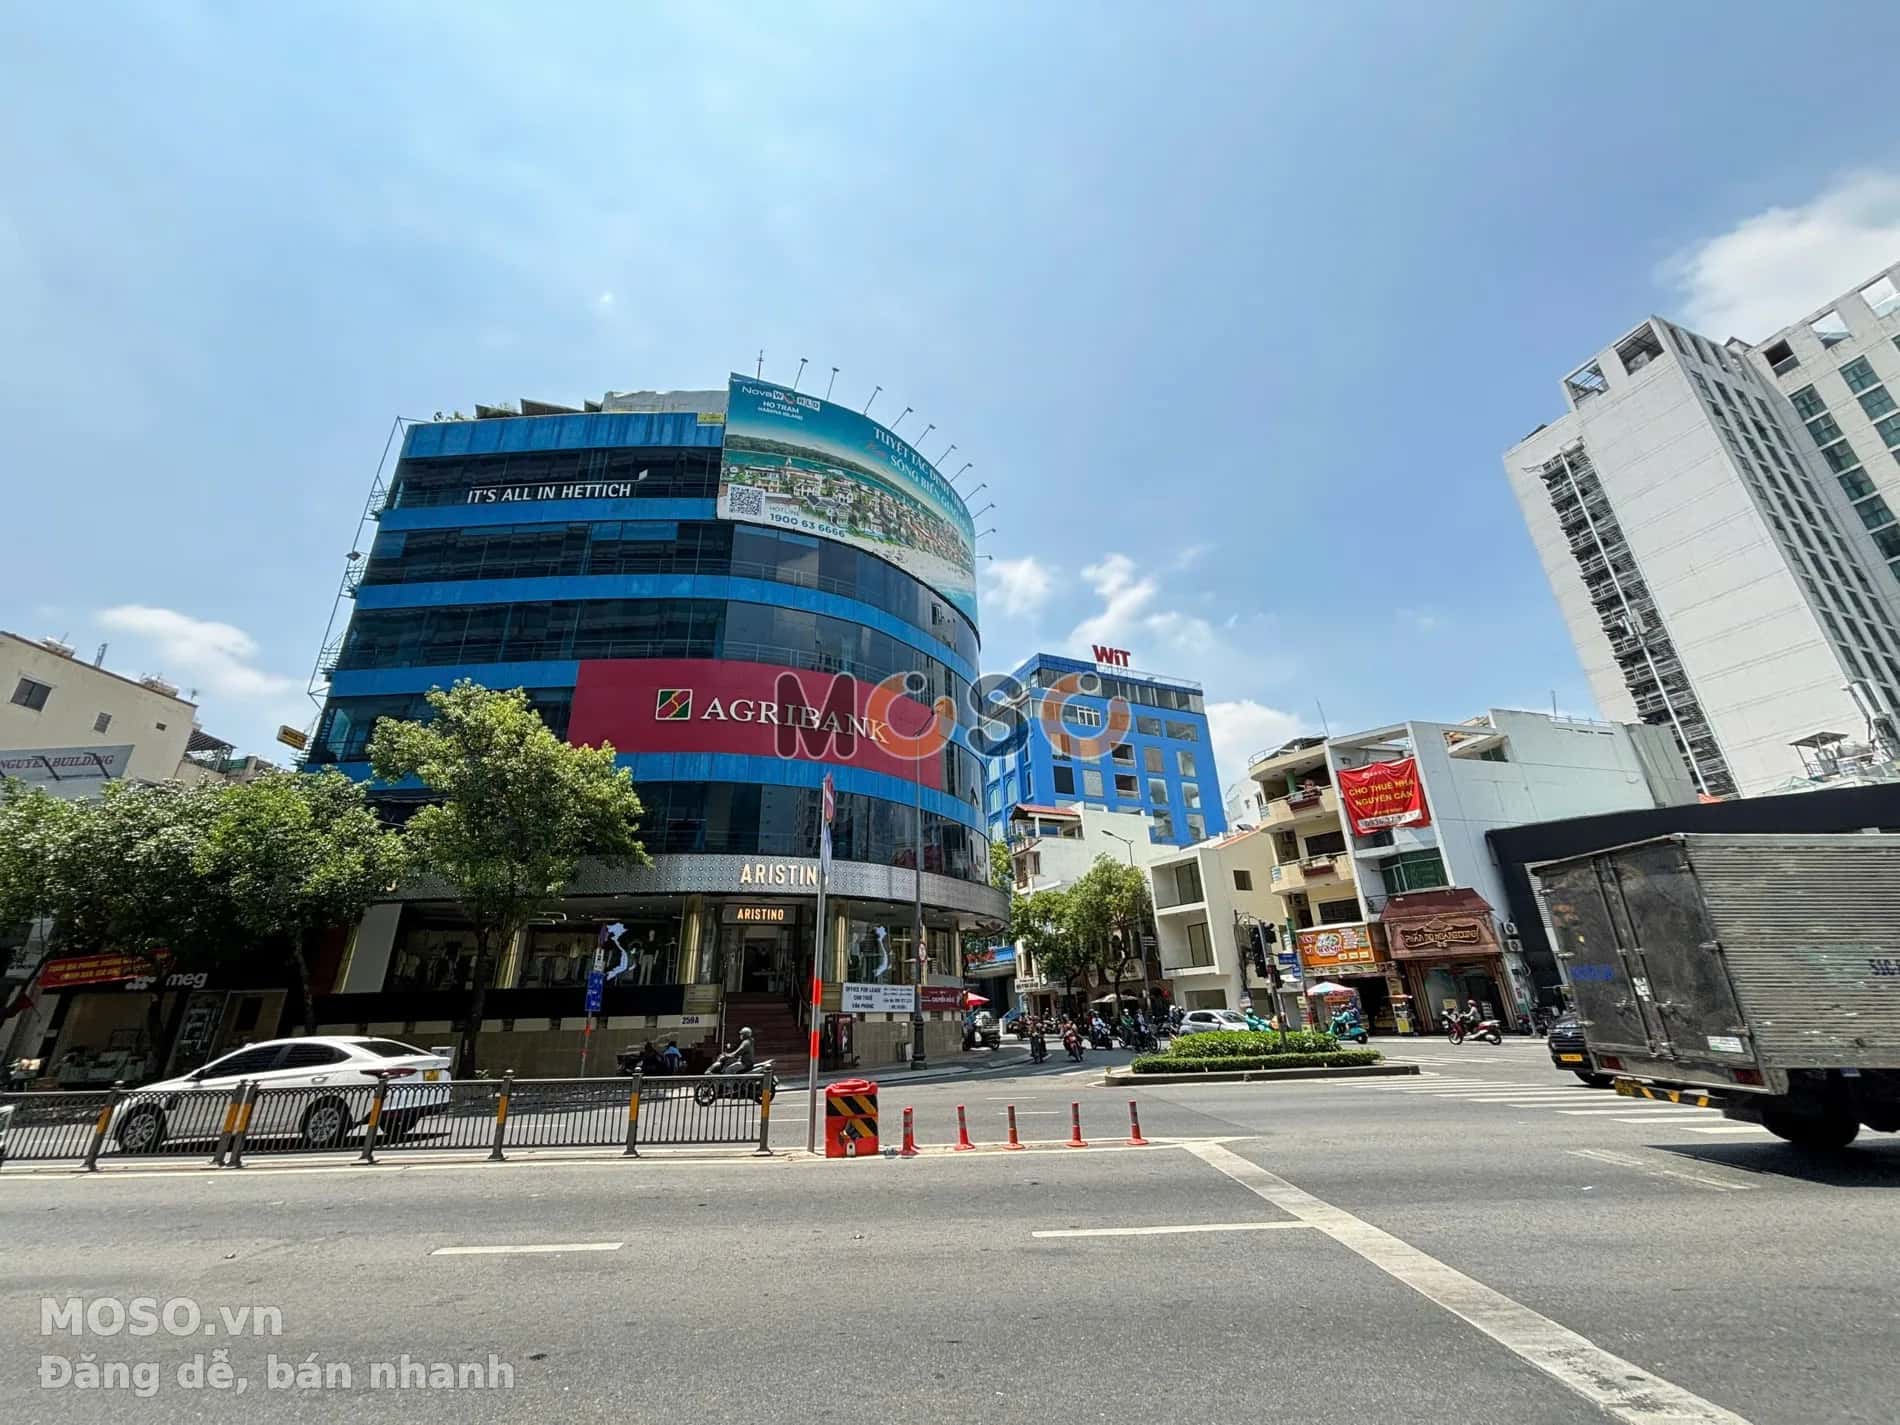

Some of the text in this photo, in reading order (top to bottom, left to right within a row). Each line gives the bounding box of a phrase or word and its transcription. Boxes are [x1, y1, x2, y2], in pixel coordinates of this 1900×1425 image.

[467, 483, 632, 504] IT'S ALL IN HETTICH
[769, 512, 846, 538] 1900 63 6666
[701, 696, 889, 745] AGRIBANK
[1349, 786, 1368, 797] CHO
[740, 863, 829, 886] ARISTIN
[737, 908, 785, 921] ARISTINO
